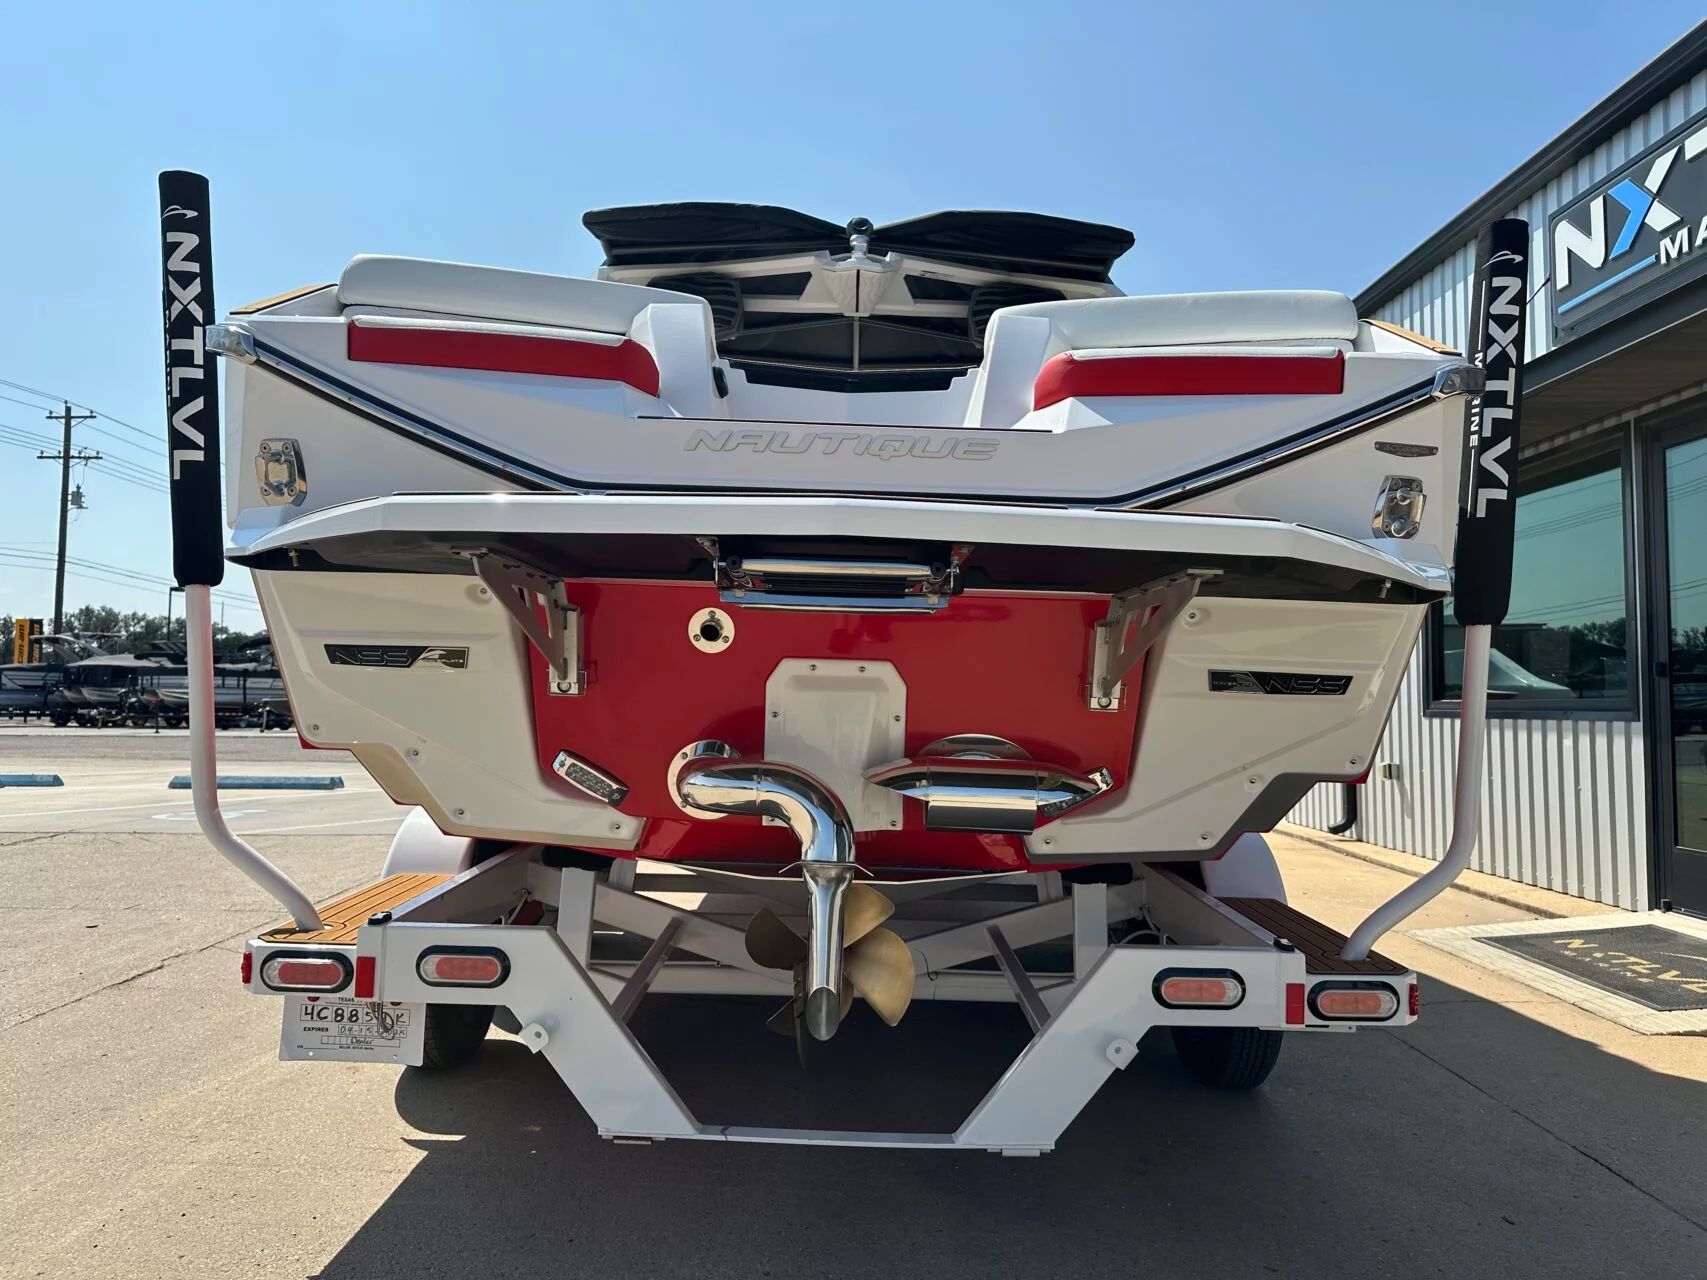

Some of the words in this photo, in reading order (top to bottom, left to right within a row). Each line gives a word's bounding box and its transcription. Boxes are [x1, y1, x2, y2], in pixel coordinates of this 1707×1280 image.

[165, 231, 205, 480] NXTLVL
[1469, 352, 1483, 448] MRINE
[1476, 276, 1521, 518] NXTLVL
[683, 429, 1000, 461] NAUTIQUE
